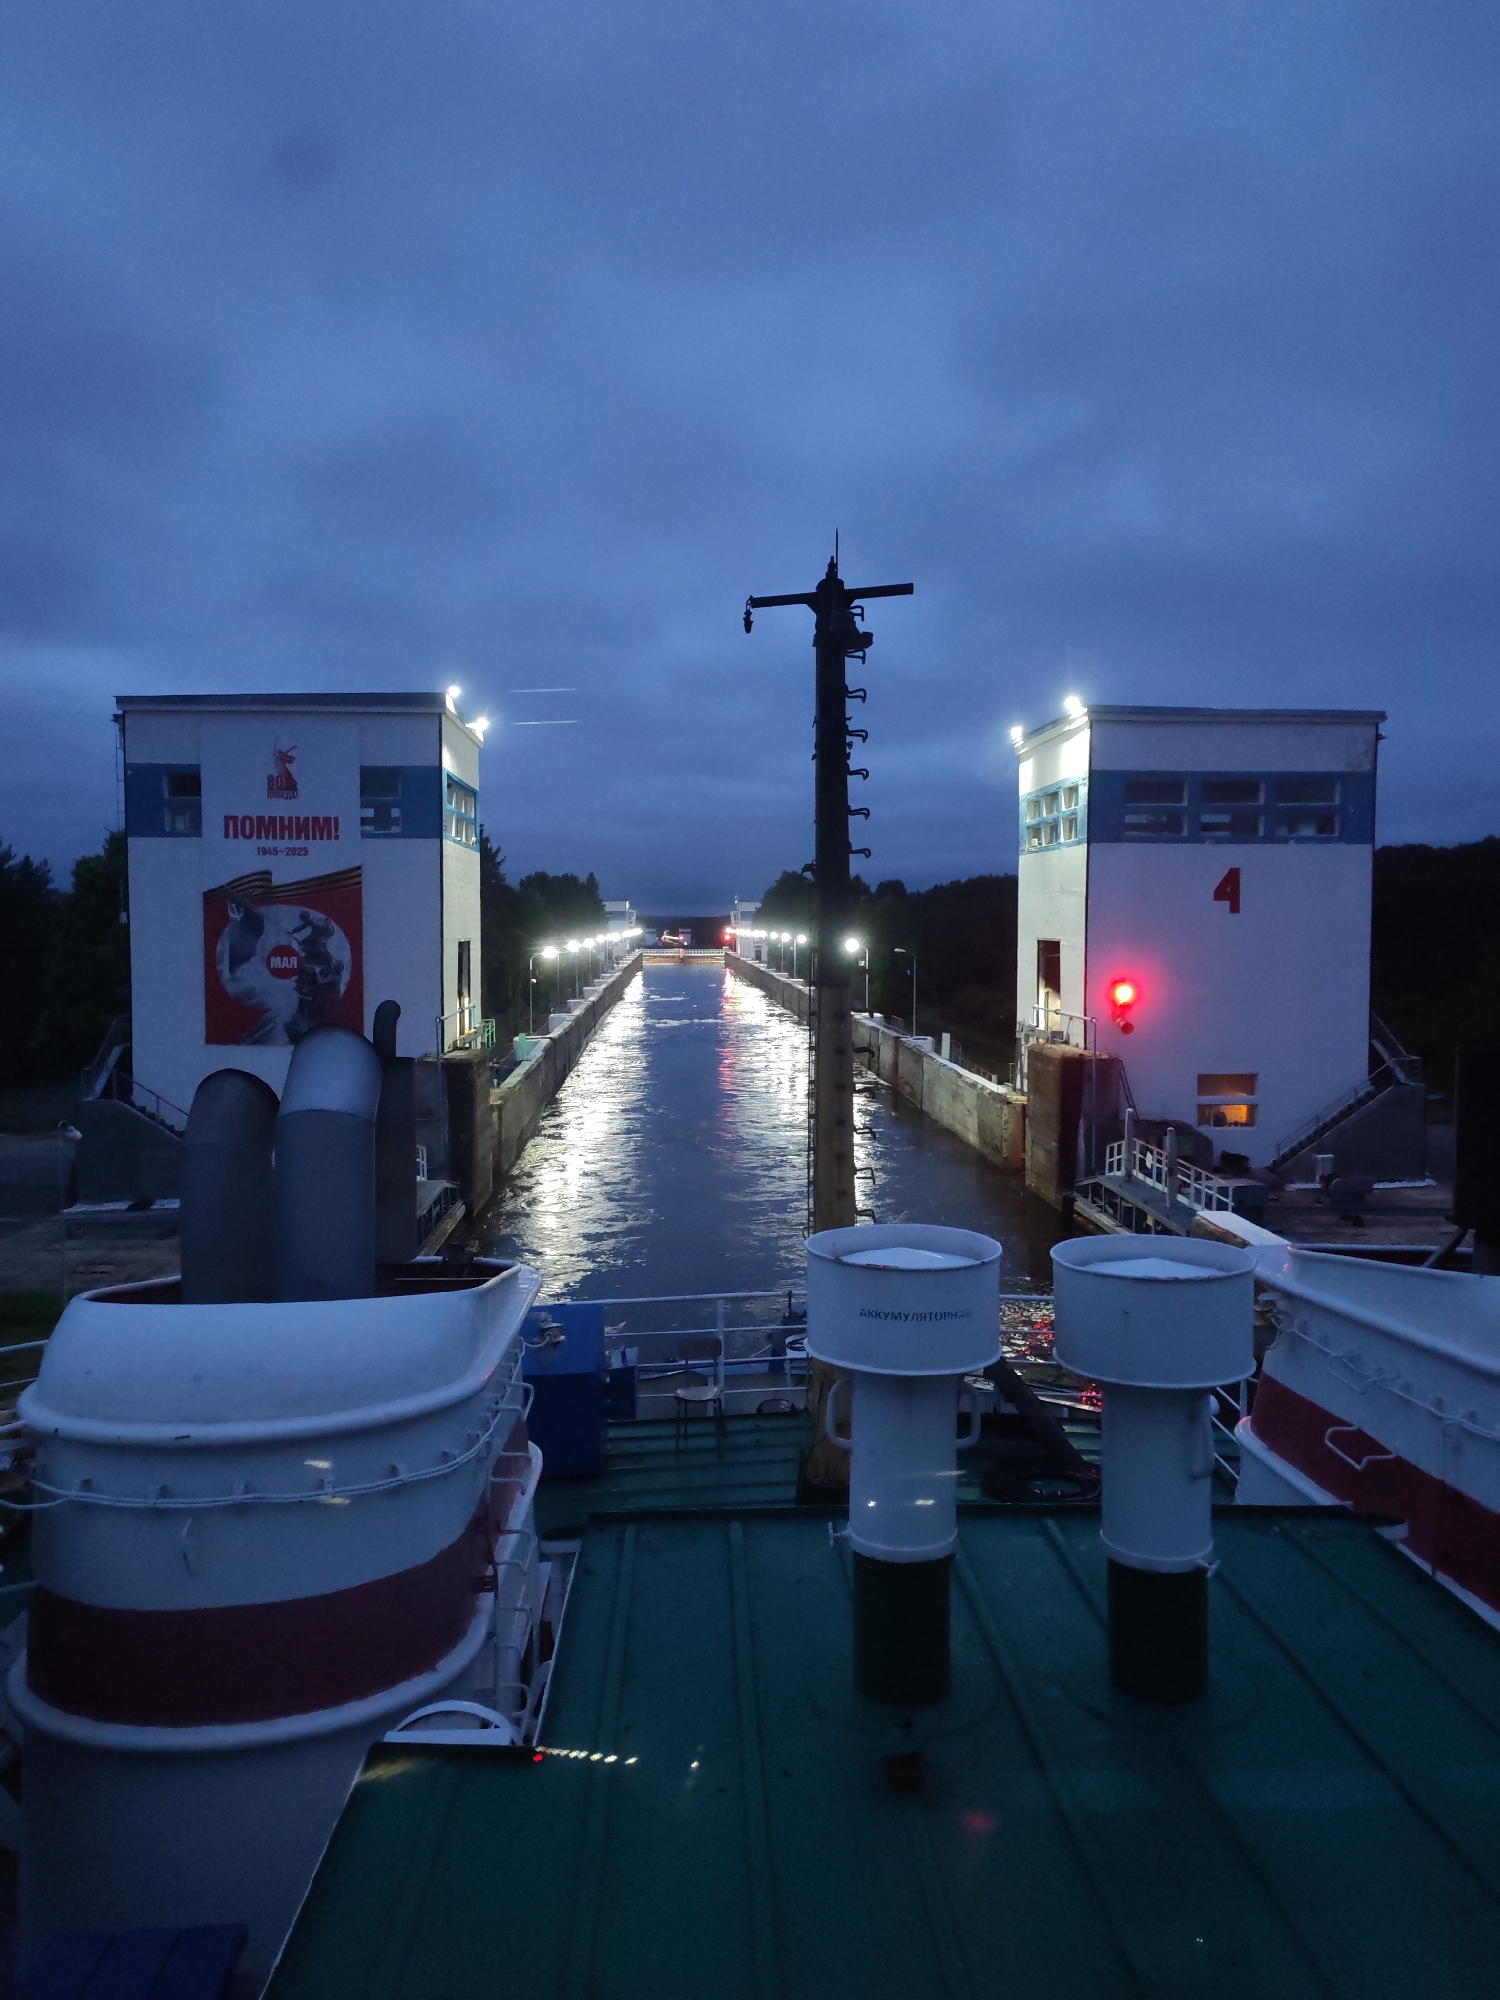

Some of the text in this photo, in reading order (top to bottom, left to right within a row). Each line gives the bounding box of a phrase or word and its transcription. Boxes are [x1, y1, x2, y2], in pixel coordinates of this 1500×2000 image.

[223, 815, 340, 841] ПОМНИМ!
[1213, 867, 1240, 914] 4
[270, 956, 298, 968] МАЯ
